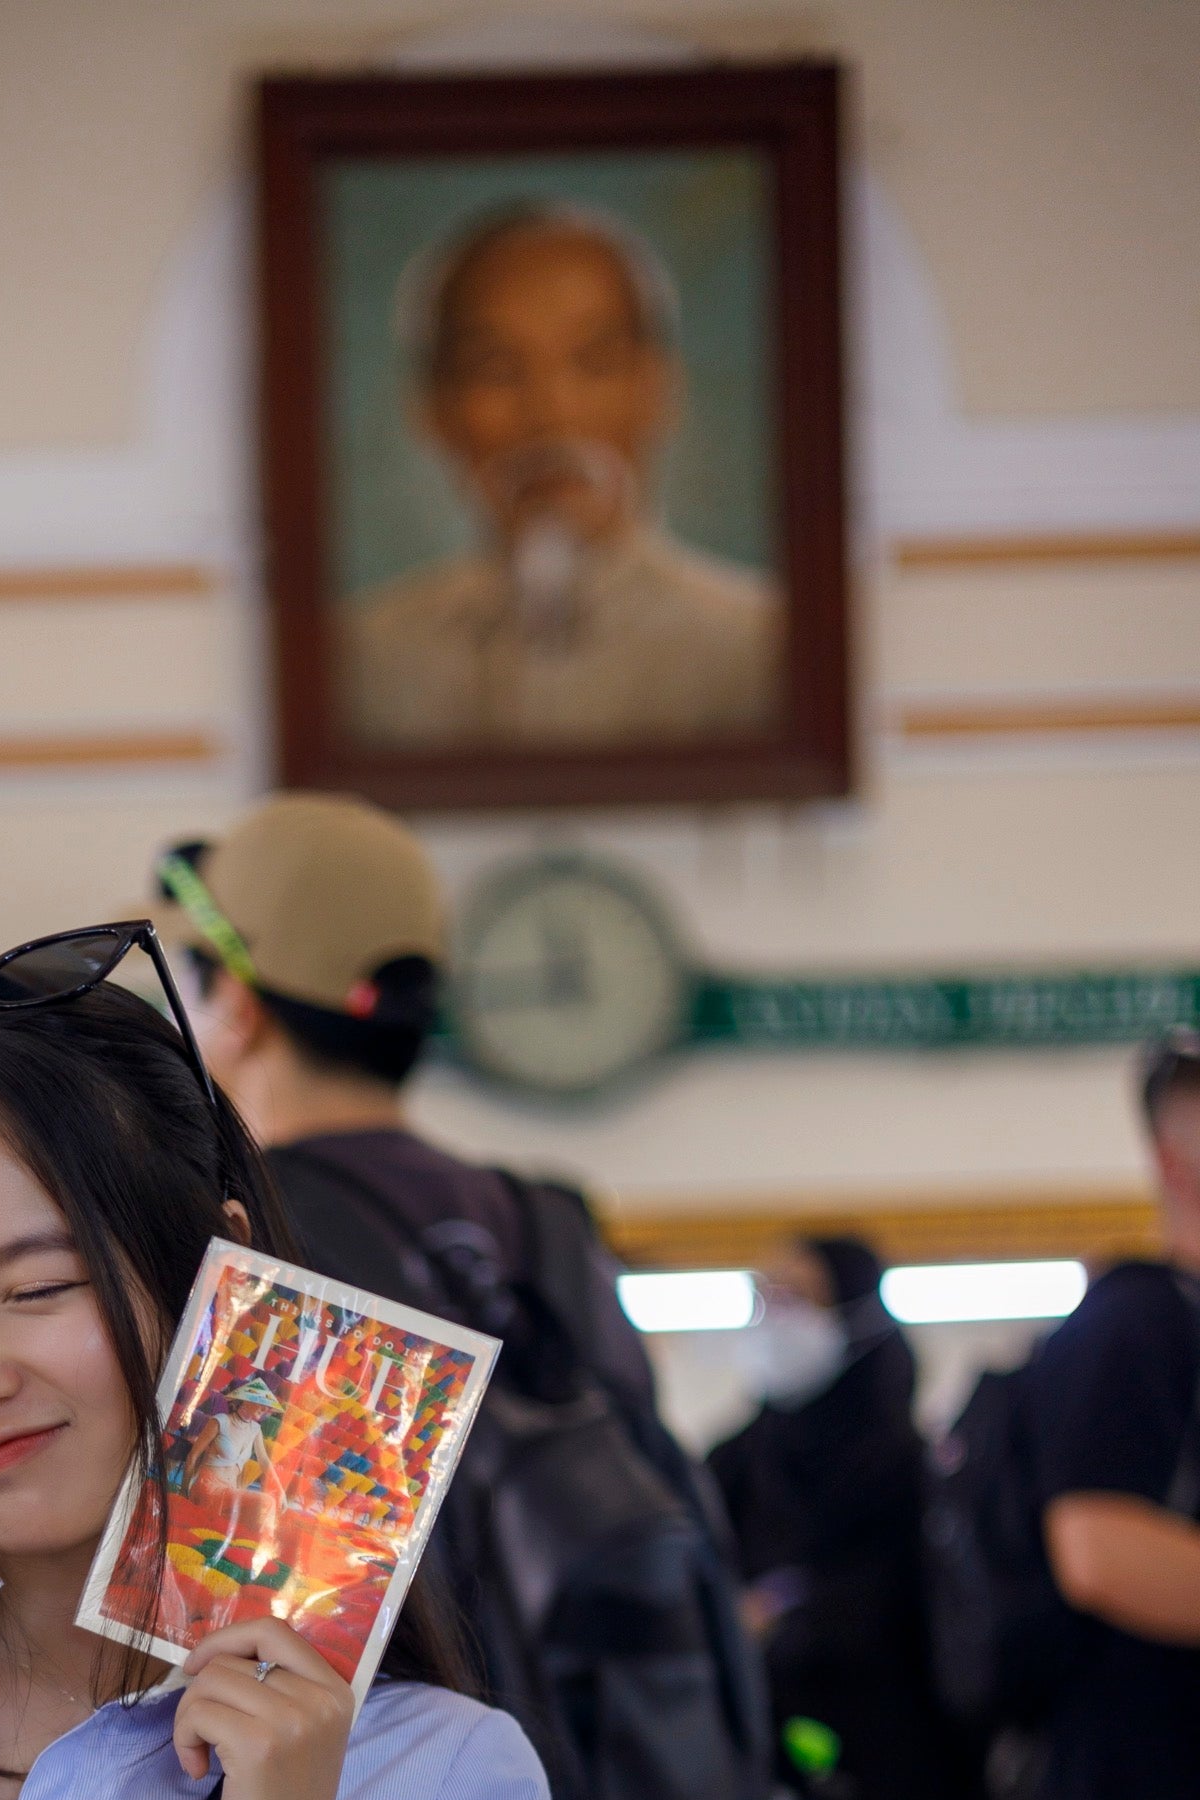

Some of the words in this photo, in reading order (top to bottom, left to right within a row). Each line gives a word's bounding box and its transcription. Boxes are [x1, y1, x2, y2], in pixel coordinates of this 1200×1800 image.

[251, 1313, 419, 1421] HUE
[270, 1298, 334, 1329] THINGS
[343, 1325, 363, 1339] TO
[372, 1336, 394, 1351] DO
[404, 1347, 423, 1361] IN
